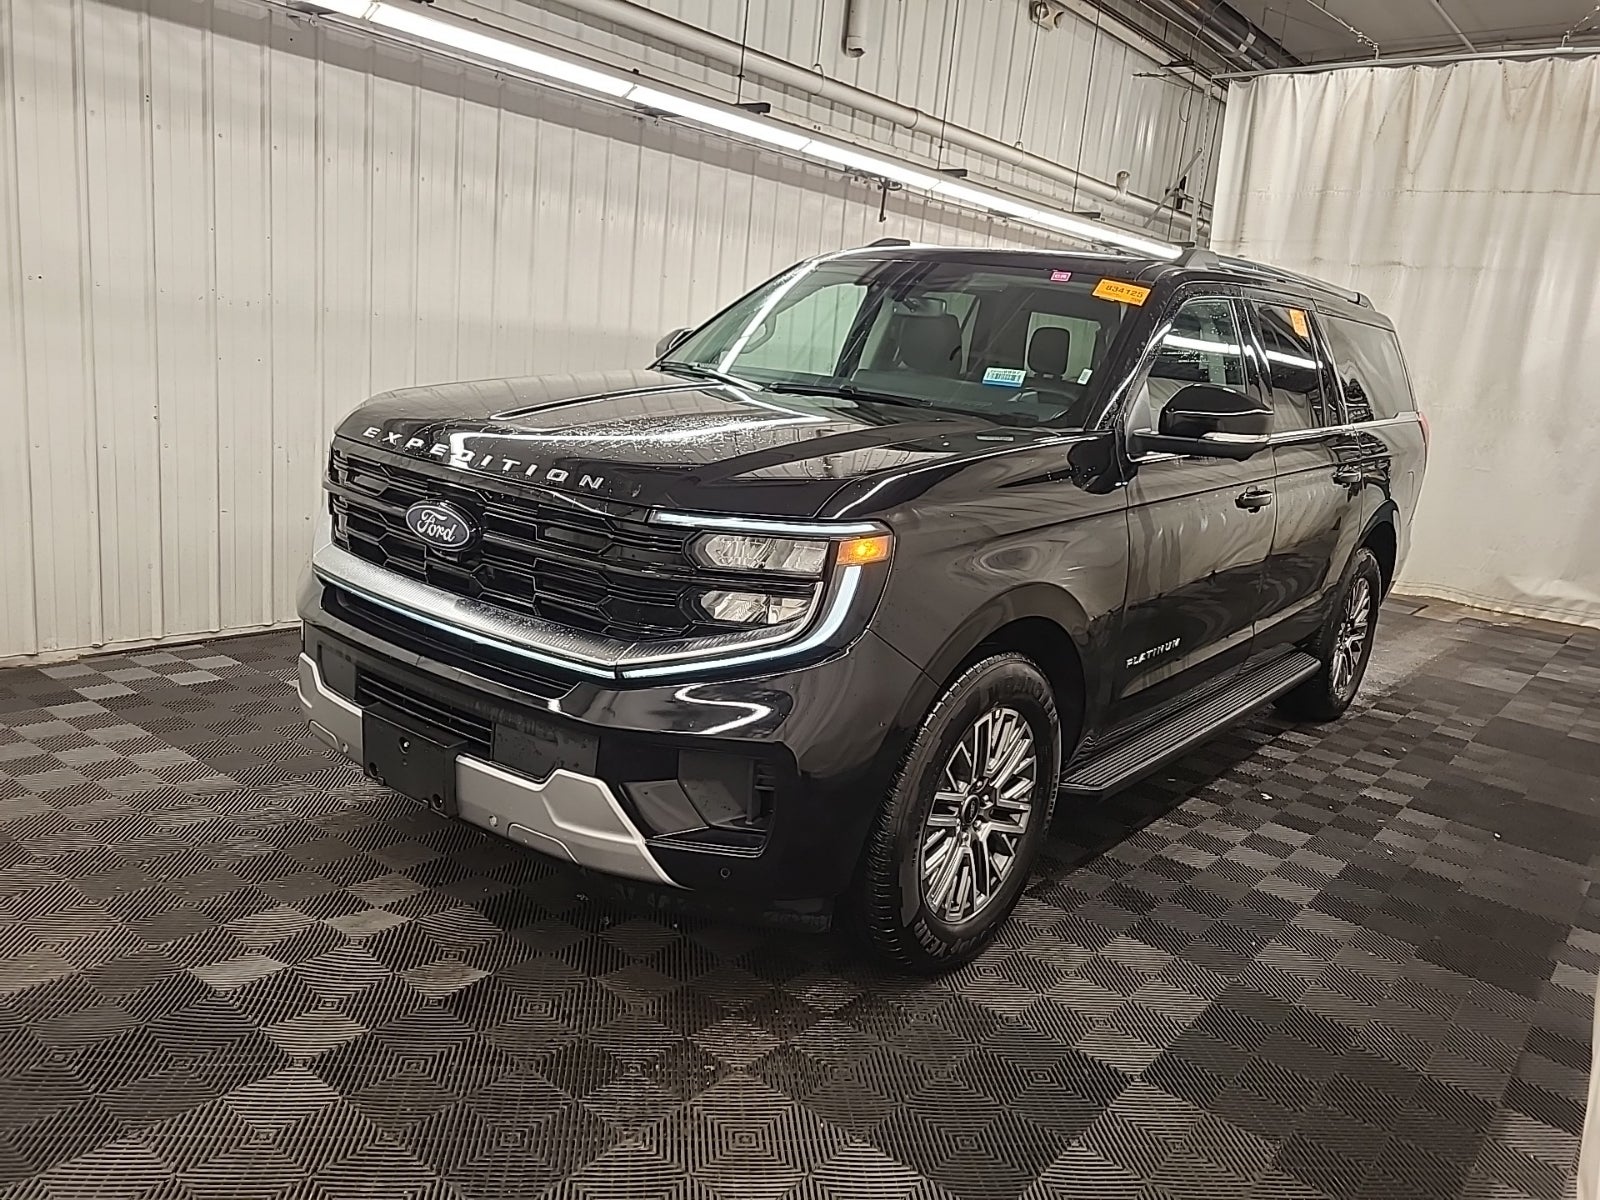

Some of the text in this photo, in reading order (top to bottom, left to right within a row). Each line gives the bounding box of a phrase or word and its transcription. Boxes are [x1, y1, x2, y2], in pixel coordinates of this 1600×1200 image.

[363, 426, 605, 490] EXPEDITION
[415, 509, 458, 543] Ford
[1126, 638, 1181, 669] PLATINUM
